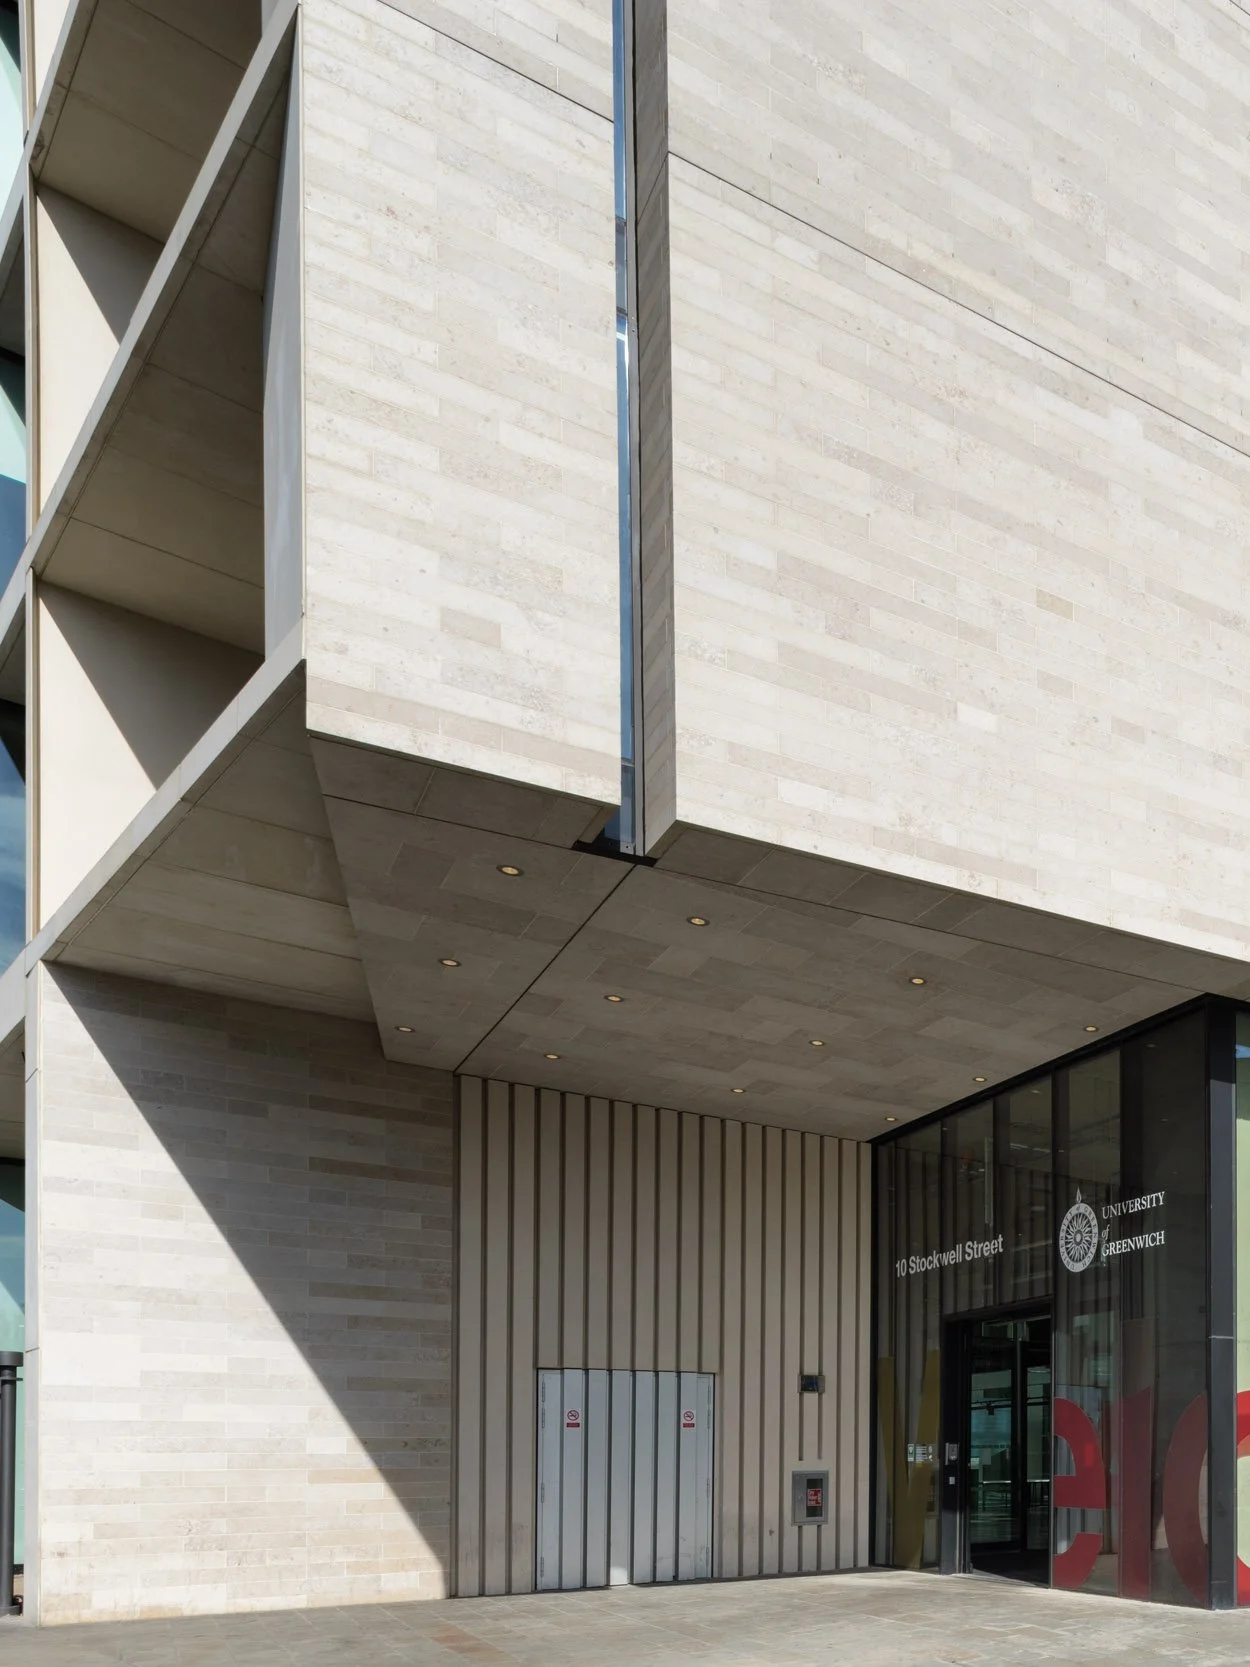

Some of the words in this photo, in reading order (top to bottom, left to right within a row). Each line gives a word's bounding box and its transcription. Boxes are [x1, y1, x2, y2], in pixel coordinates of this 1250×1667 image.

[1102, 1191, 1165, 1219] UNIVERSITY
[1102, 1224, 1110, 1240] of
[1102, 1231, 1165, 1256] GREENWICH
[896, 1258, 907, 1278] 10
[909, 1243, 963, 1274] Stockwell
[965, 1234, 1003, 1261] Street
